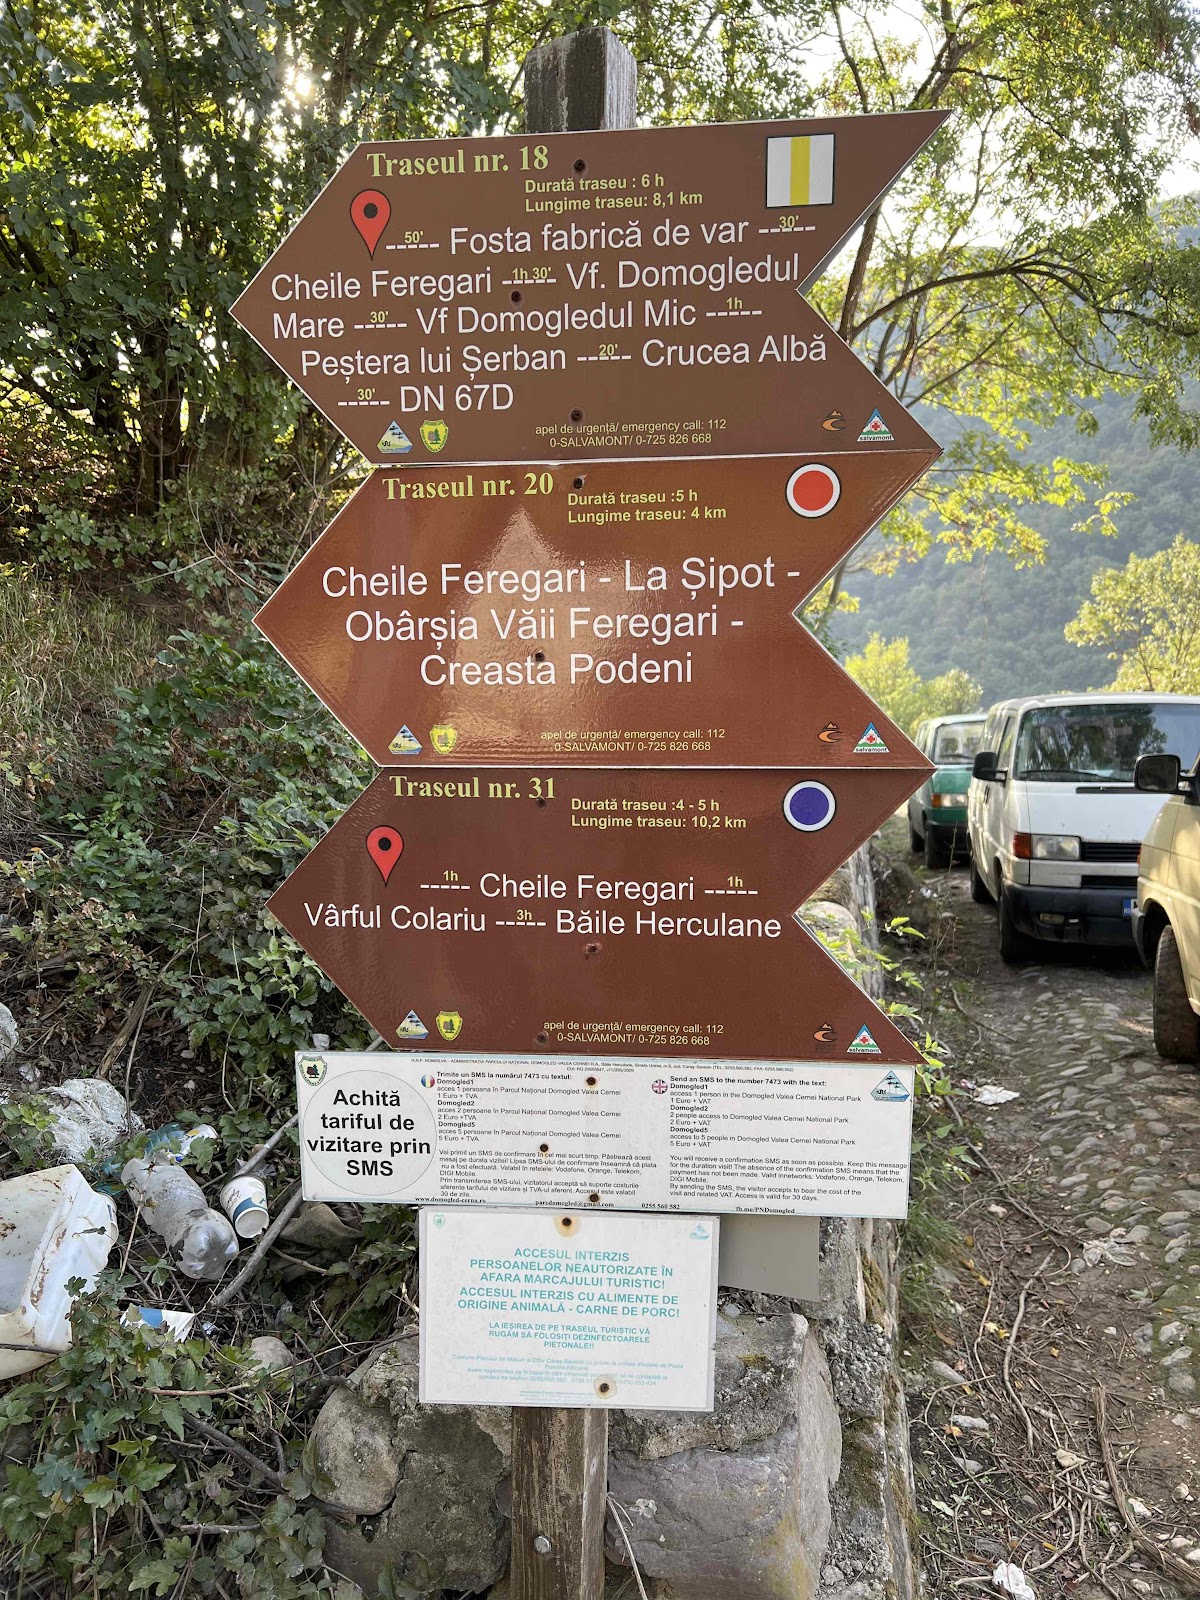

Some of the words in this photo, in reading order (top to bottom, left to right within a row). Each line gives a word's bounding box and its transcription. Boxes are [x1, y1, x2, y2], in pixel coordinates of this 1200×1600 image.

[366, 149, 465, 176] Traseul
[473, 153, 508, 172] nr.
[518, 145, 548, 170] 18
[525, 177, 574, 193] Durată
[578, 178, 626, 190] traseu
[641, 173, 650, 187] 6
[654, 173, 664, 186] h
[525, 196, 590, 214] Lungime
[594, 196, 647, 209] traseu:
[652, 191, 673, 208] 8,1
[680, 191, 702, 204] km
[450, 226, 531, 254] Fosta
[541, 219, 642, 251] fabrică
[652, 218, 690, 246] de
[700, 221, 749, 244] var
[271, 271, 360, 300] Cheile
[372, 266, 491, 302] Feregari
[512, 267, 528, 279] 1h
[566, 261, 605, 289] Vf.
[618, 253, 799, 292] Domogledul
[273, 312, 344, 338] Mare
[415, 306, 448, 334] Vf
[458, 300, 632, 337] Domogledul
[644, 298, 696, 326] Mic
[726, 296, 742, 309] 1h
[300, 350, 410, 385] Peștera
[420, 346, 450, 373] lui
[462, 344, 565, 380] Șerban
[642, 339, 749, 366] Crucea
[758, 333, 826, 362] Albă
[400, 385, 444, 412] DN
[455, 383, 513, 411] 67D
[535, 423, 557, 436] apel
[560, 423, 573, 434] de
[621, 422, 680, 433] emergency
[682, 419, 703, 430] call:
[708, 418, 726, 429] 112
[549, 433, 633, 447] 0-SALVAMONT/
[635, 434, 665, 445] 0-725
[668, 433, 688, 444] 826
[691, 432, 711, 443] 668
[382, 474, 474, 499] Traseul
[482, 479, 515, 496] nr.
[523, 472, 553, 494] 20
[568, 491, 615, 505] Durată
[619, 492, 665, 504] traseu
[688, 488, 697, 501] h
[568, 509, 631, 525] Lungime
[634, 509, 685, 521] traseu:
[690, 506, 700, 518] 4
[704, 506, 726, 518] km
[322, 564, 427, 597] Cheile
[441, 560, 585, 604] Feregari
[624, 558, 668, 592] La
[681, 556, 775, 600] Șipot
[346, 609, 478, 650] Obârșia
[490, 608, 554, 639] Văii
[570, 604, 716, 645] Feregari
[420, 654, 555, 685] Creasta
[570, 651, 691, 684] Podeni
[540, 730, 561, 740] apel
[564, 730, 577, 740] de
[624, 730, 680, 742] emergency
[682, 728, 703, 738] call:
[707, 728, 725, 738] 112
[554, 740, 635, 752] 0-SALVAMONT/
[637, 740, 666, 751] 0-725
[669, 741, 688, 751] 826
[691, 741, 711, 750] 668
[389, 775, 480, 797] Traseul
[488, 782, 520, 798] nr.
[528, 777, 555, 799] 31
[571, 798, 617, 810] Durată
[621, 799, 666, 810] traseu
[698, 799, 706, 811] 5
[710, 799, 719, 811] h
[571, 814, 632, 829] Lungime
[636, 815, 686, 827] traseu:
[691, 815, 720, 829] 10,2
[724, 815, 746, 828] km
[443, 870, 458, 881] 1h
[480, 872, 566, 898] Cheile
[578, 874, 693, 906] Feregari
[727, 875, 743, 887] 1h
[303, 902, 380, 928] Vârful
[390, 905, 485, 931] Colariu
[516, 909, 532, 920] 3h
[556, 909, 625, 934] Băile
[636, 910, 781, 937] Herculane
[543, 1020, 564, 1033] apel
[566, 1020, 579, 1031] de
[625, 1024, 681, 1035] emergency
[682, 1024, 703, 1034] call:
[706, 1024, 723, 1034] 112
[557, 1032, 636, 1043] 0-SALVAMONT/
[638, 1034, 667, 1044] 0-725
[669, 1034, 688, 1044] 826
[690, 1035, 709, 1045] 668
[670, 1082, 708, 1091] Domogled1
[332, 1089, 400, 1106] Achită
[320, 1113, 381, 1129] tariful
[389, 1114, 414, 1130] de
[306, 1135, 382, 1153] vizitare
[390, 1138, 430, 1157] prin
[346, 1159, 393, 1176] SMS
[513, 1247, 571, 1259] ACCESUL
[575, 1250, 629, 1262] INTERZIS
[470, 1258, 562, 1272] PERSOANELOR
[565, 1263, 657, 1276] NEAUTORIZATE
[661, 1265, 673, 1276] ÎN
[479, 1271, 521, 1283] AFARA
[524, 1273, 602, 1287] MARCAJULUI
[605, 1277, 664, 1289] TURISTIC!
[459, 1286, 517, 1298] ACCESUL
[520, 1289, 574, 1301] INTERZIS
[577, 1291, 594, 1301] CU
[597, 1292, 658, 1304] ALIMENTE
[662, 1295, 678, 1305] DE
[457, 1299, 507, 1310] ORIGINE
[510, 1301, 565, 1313] ANIMALĂ
[575, 1304, 618, 1315] CARNE
[621, 1305, 638, 1316] DE
[641, 1306, 680, 1317] PORC!
